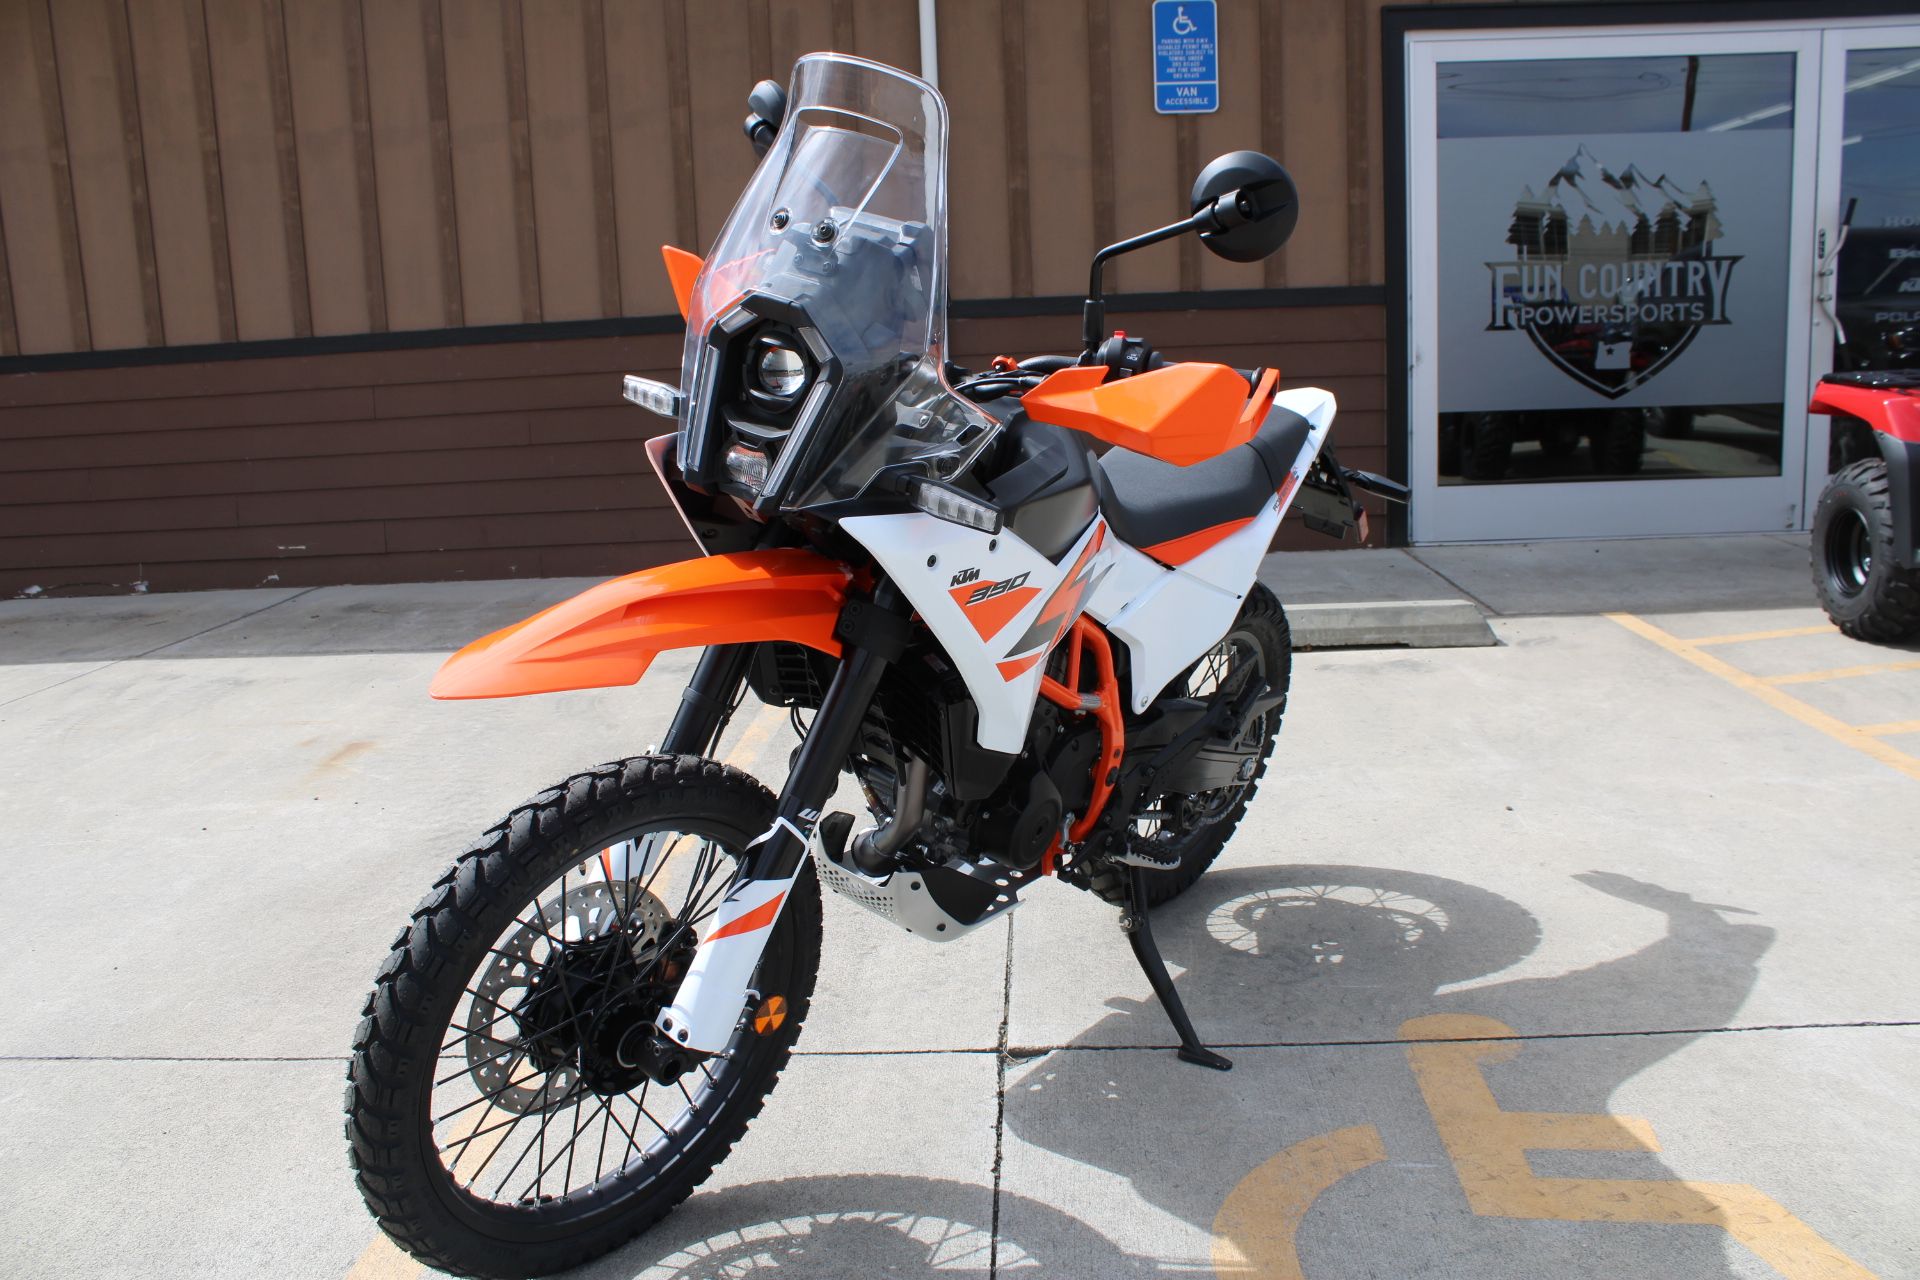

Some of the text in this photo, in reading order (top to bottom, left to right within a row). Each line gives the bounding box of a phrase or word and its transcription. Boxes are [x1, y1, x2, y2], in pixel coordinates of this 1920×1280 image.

[1165, 97, 1209, 105] ACCESSIBLE
[1176, 87, 1198, 97] VAN
[1484, 255, 1746, 331] FUN COUNTRY
[1519, 302, 1706, 327] POWERSPORTS
[950, 567, 981, 587] KTM
[965, 571, 1032, 607] 390
